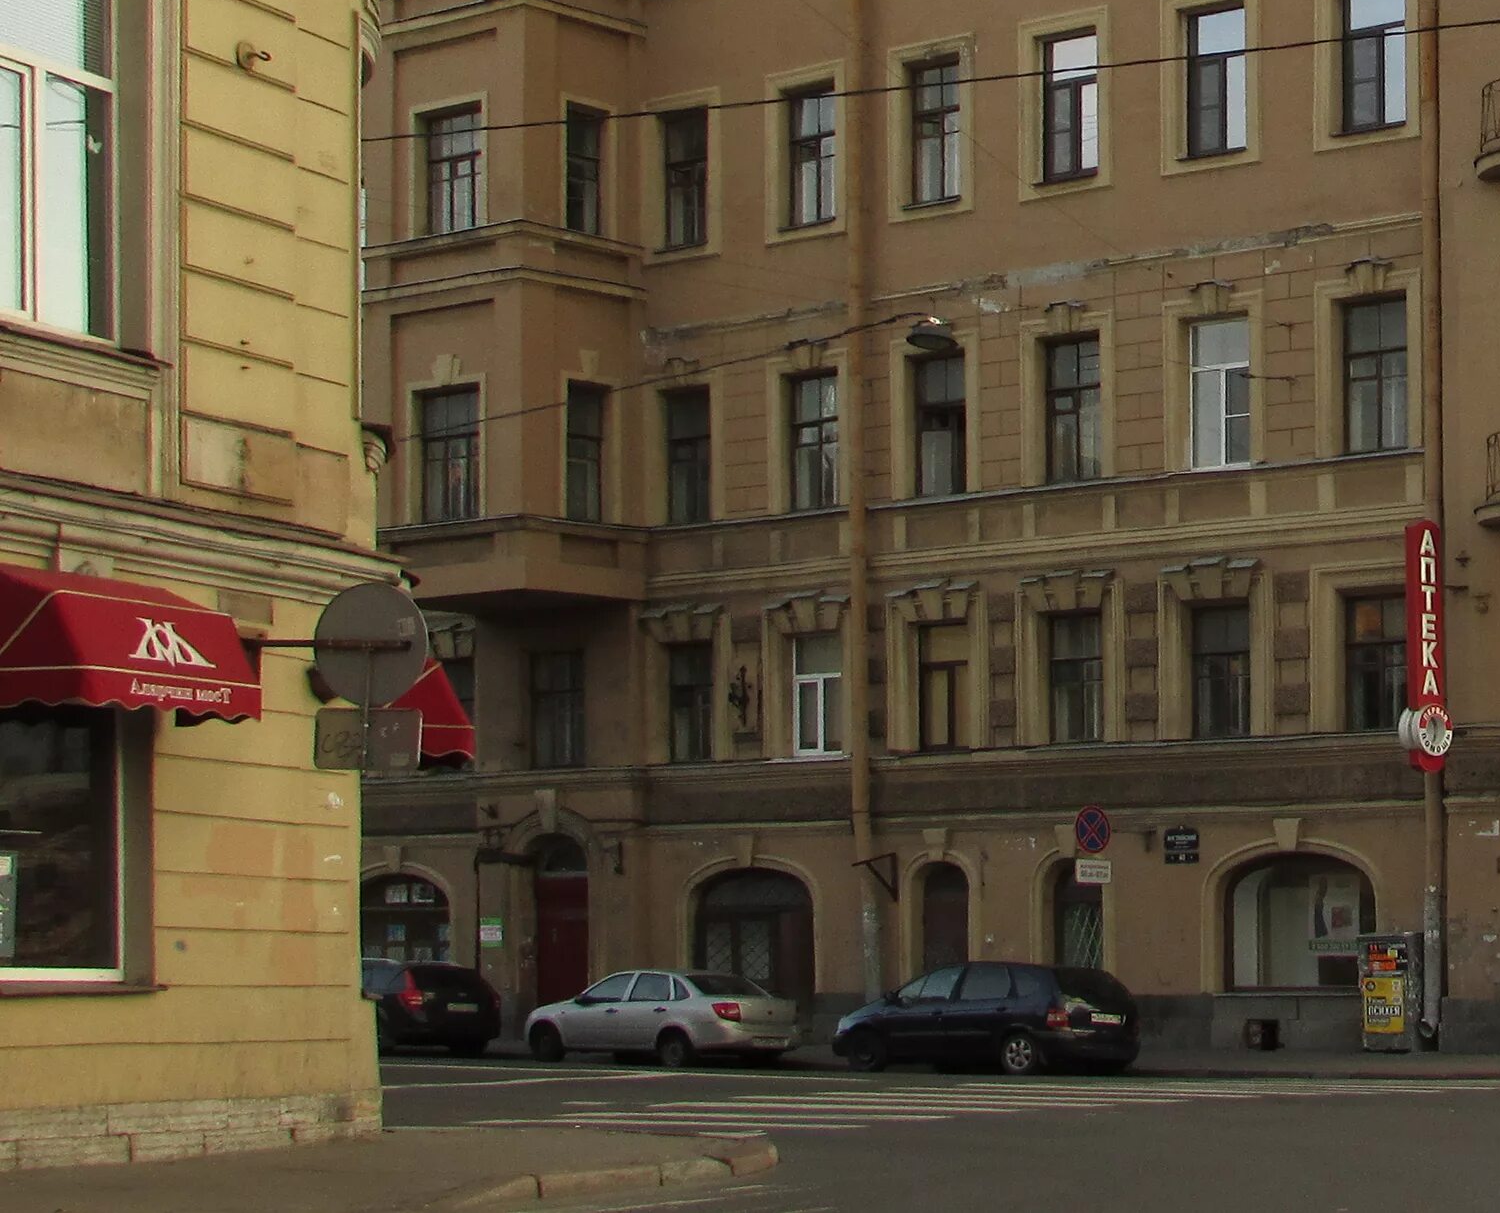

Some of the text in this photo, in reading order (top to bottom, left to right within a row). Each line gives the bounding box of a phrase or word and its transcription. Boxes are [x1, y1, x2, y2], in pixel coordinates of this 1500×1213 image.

[1419, 528, 1440, 697] АПТЕКА
[1422, 706, 1449, 722] ПЕРВАЯ
[1420, 732, 1451, 753] ПОМОЩЬ
